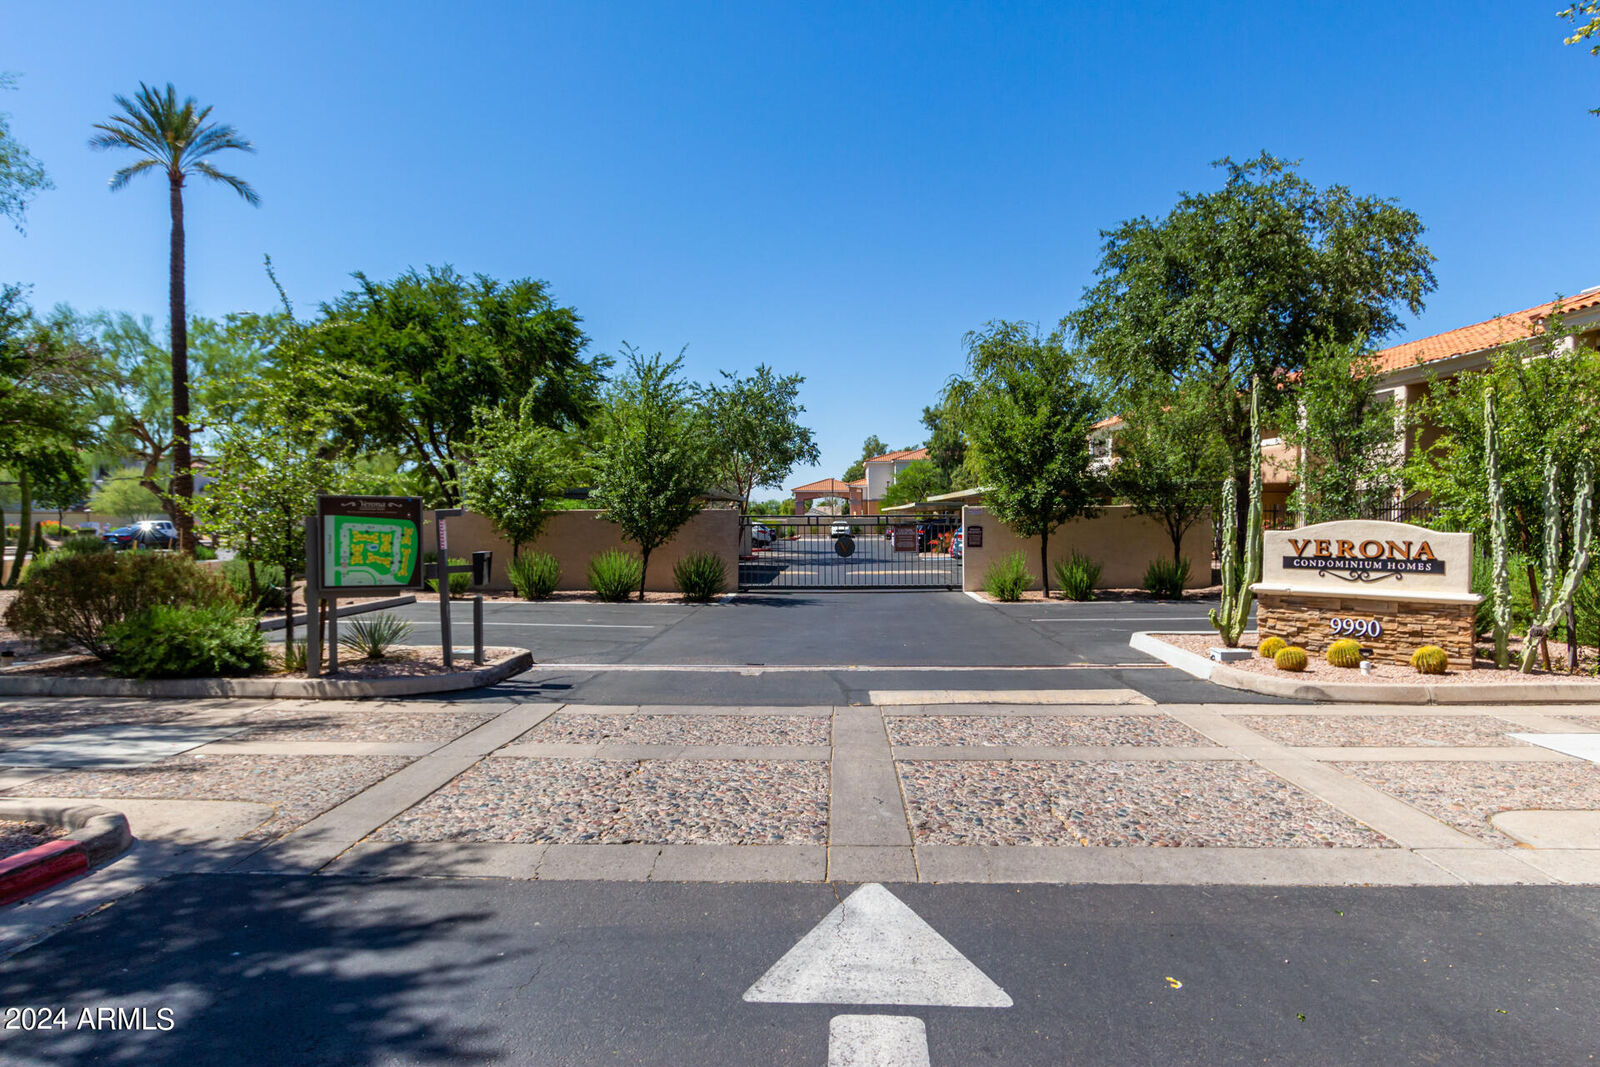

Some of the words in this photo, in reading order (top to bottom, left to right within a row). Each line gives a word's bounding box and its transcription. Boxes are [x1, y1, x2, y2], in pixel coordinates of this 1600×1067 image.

[1288, 538, 1437, 560] VERONA
[1293, 559, 1382, 569] CONDOMINIUM
[1387, 562, 1432, 571] HOMES
[1330, 617, 1381, 638] 9990
